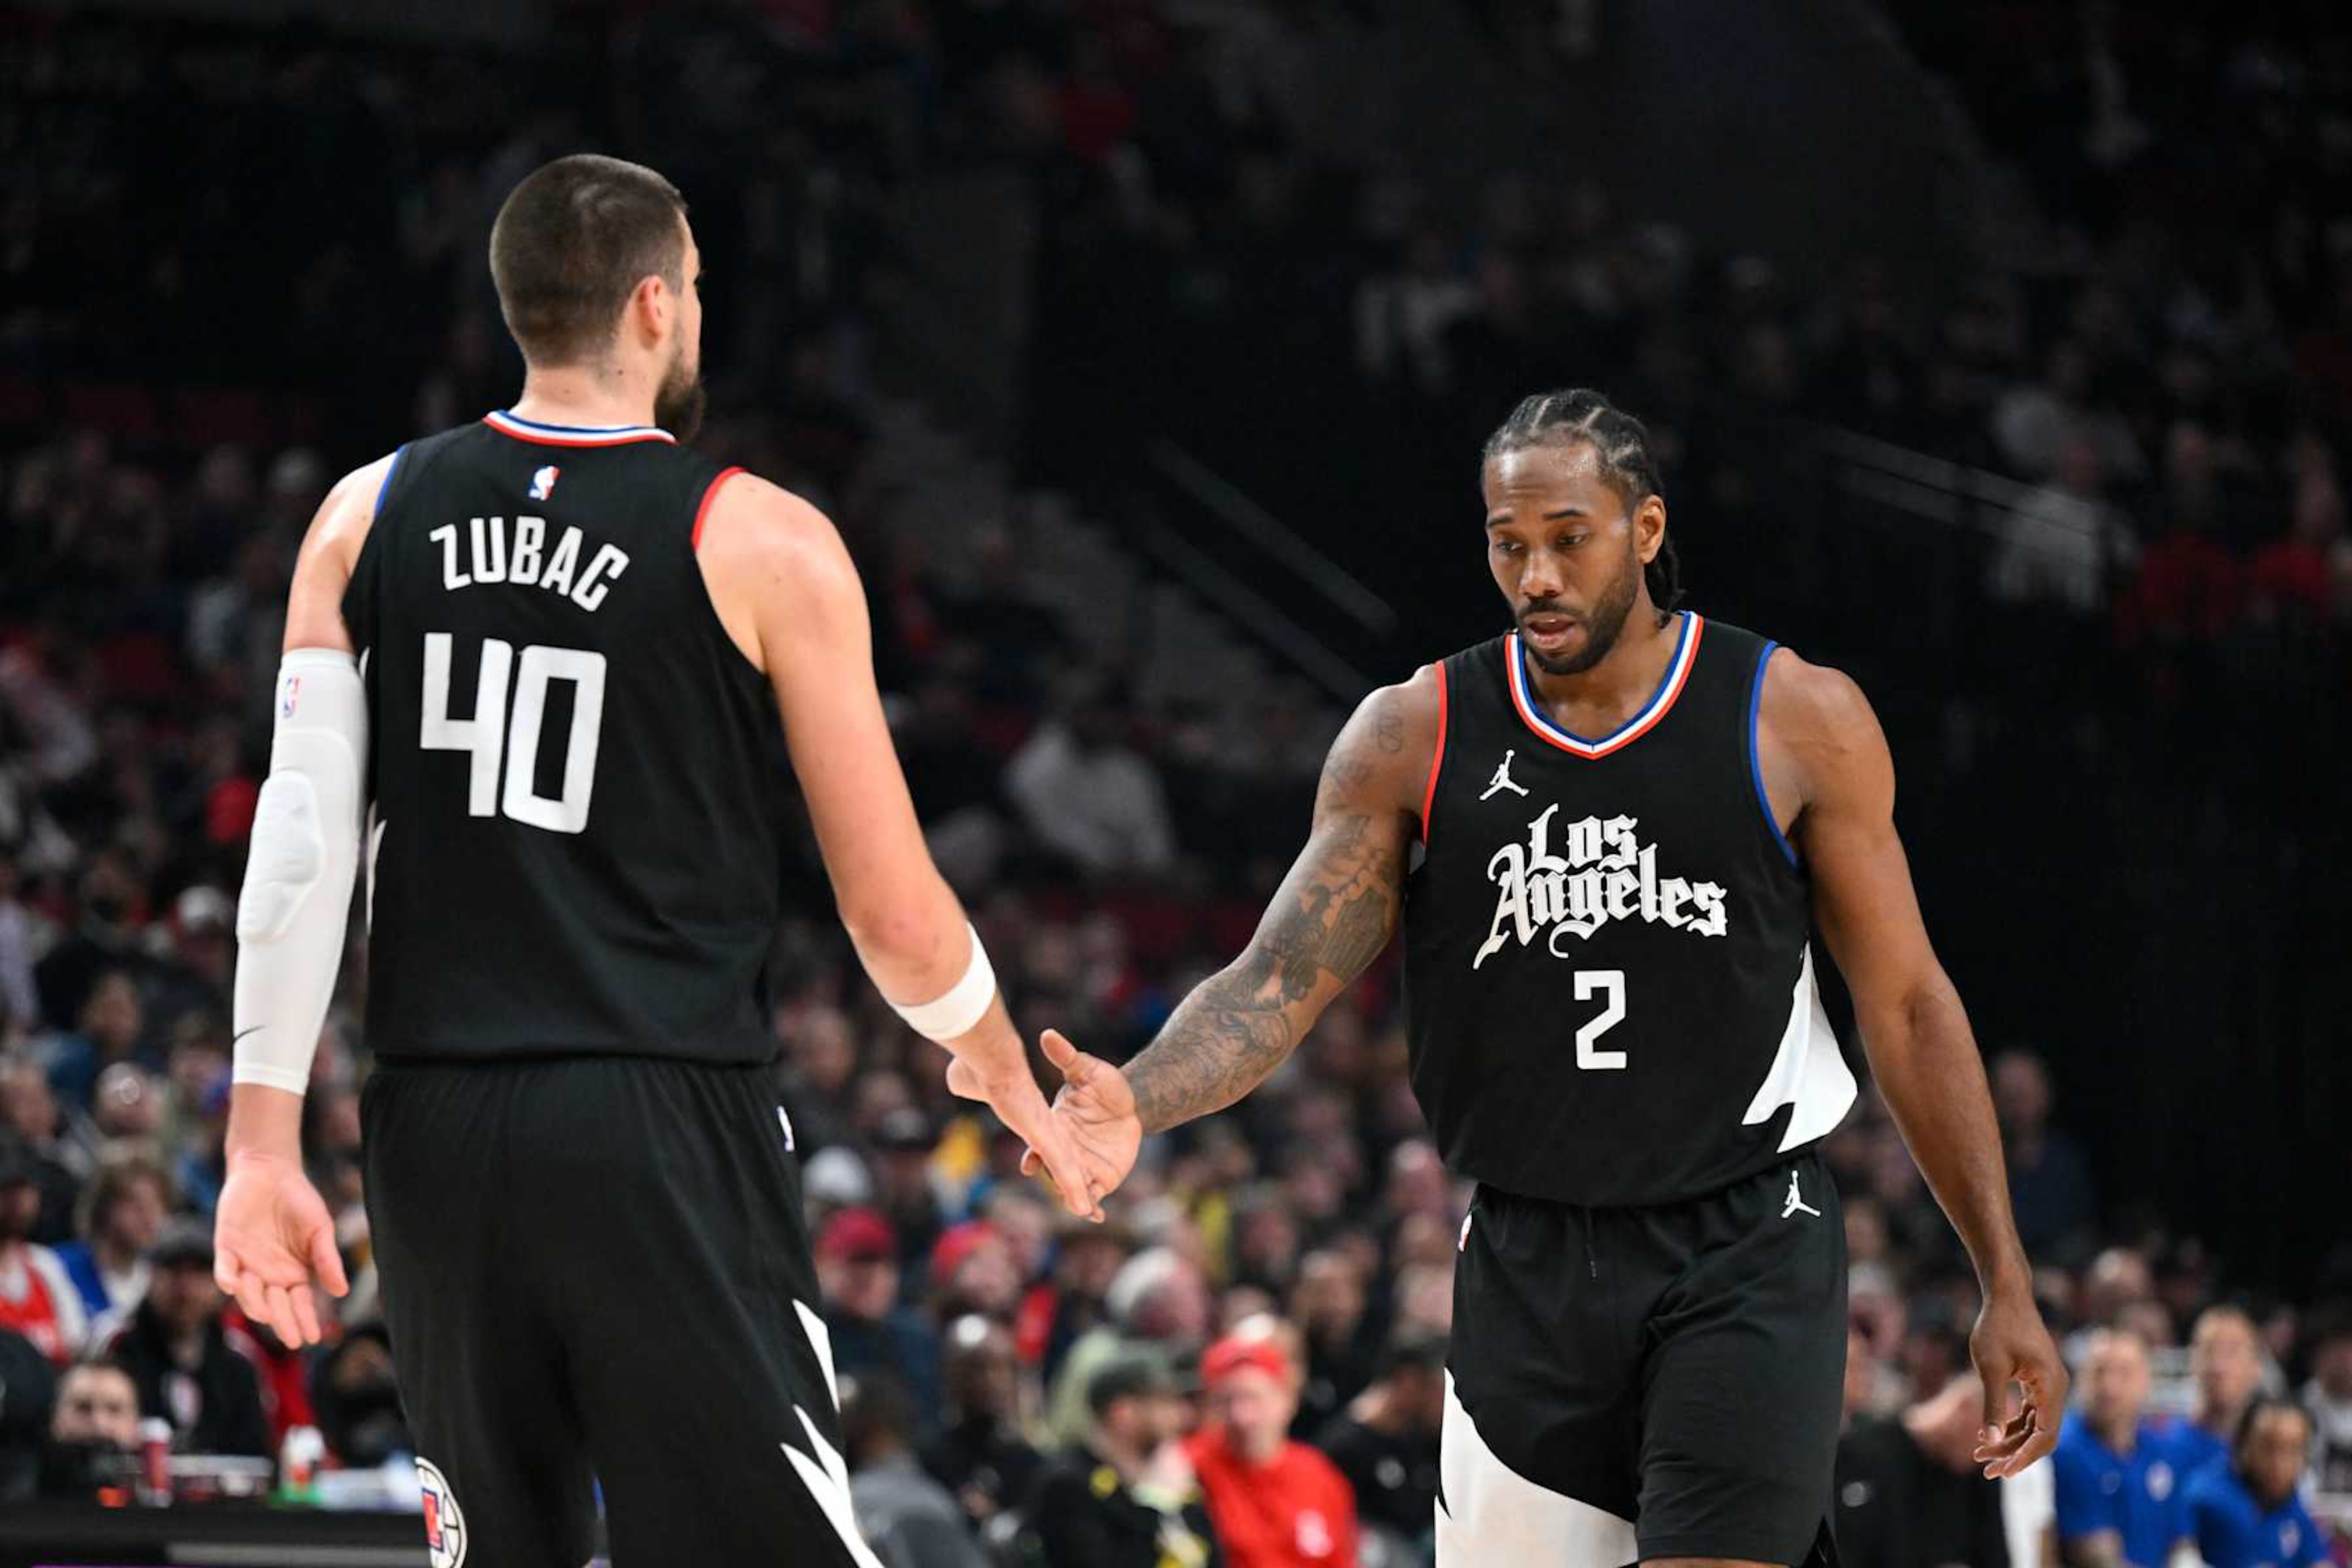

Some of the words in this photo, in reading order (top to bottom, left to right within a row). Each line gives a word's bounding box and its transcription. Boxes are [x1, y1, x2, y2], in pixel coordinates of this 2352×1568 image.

[429, 516, 630, 611] ZUBAC
[420, 632, 607, 834] 40
[1525, 803, 1638, 877] Los
[1473, 843, 1728, 970] Angeles
[1574, 970, 1627, 1069] 2
